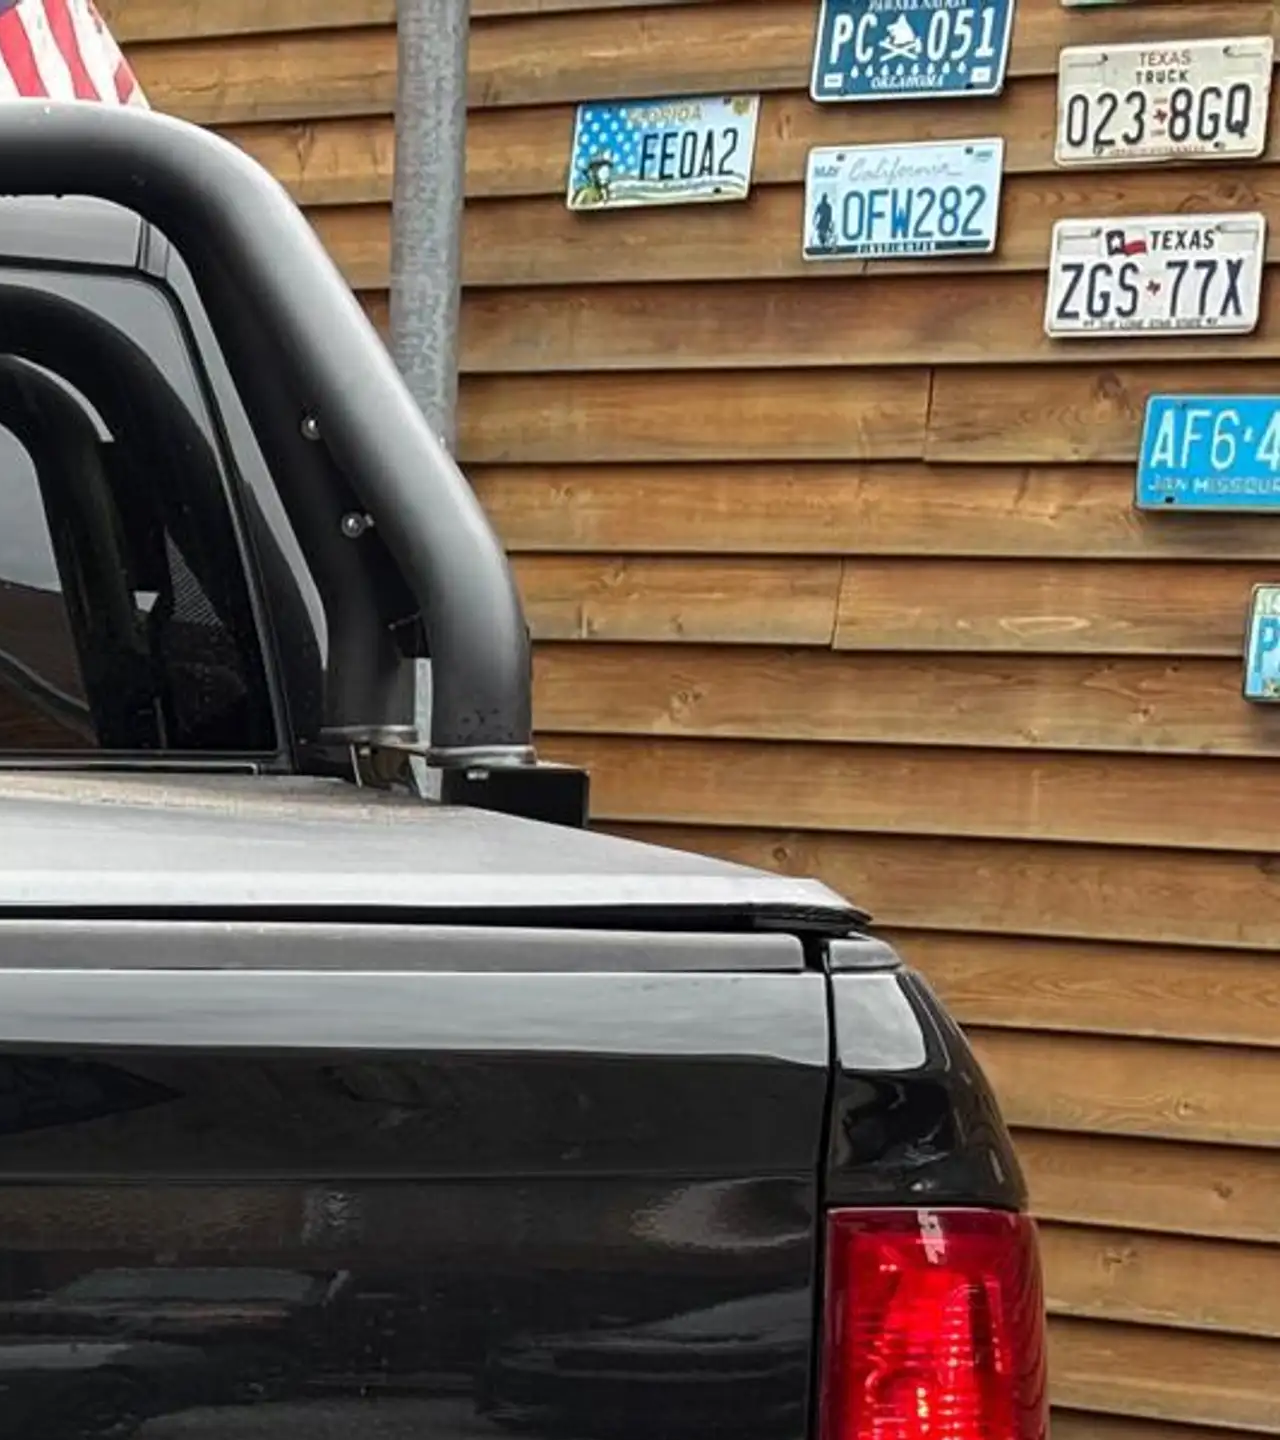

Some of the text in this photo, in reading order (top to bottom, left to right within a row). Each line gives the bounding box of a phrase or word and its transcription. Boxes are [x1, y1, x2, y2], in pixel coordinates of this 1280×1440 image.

[829, 7, 997, 65] PC 051
[1135, 70, 1190, 85] TRUCK
[1139, 48, 1192, 67] TEXAS
[1066, 82, 1252, 147] 023 8GQ
[1149, 229, 1216, 251] TEXAS
[1056, 258, 1244, 320] ZGS 77X
